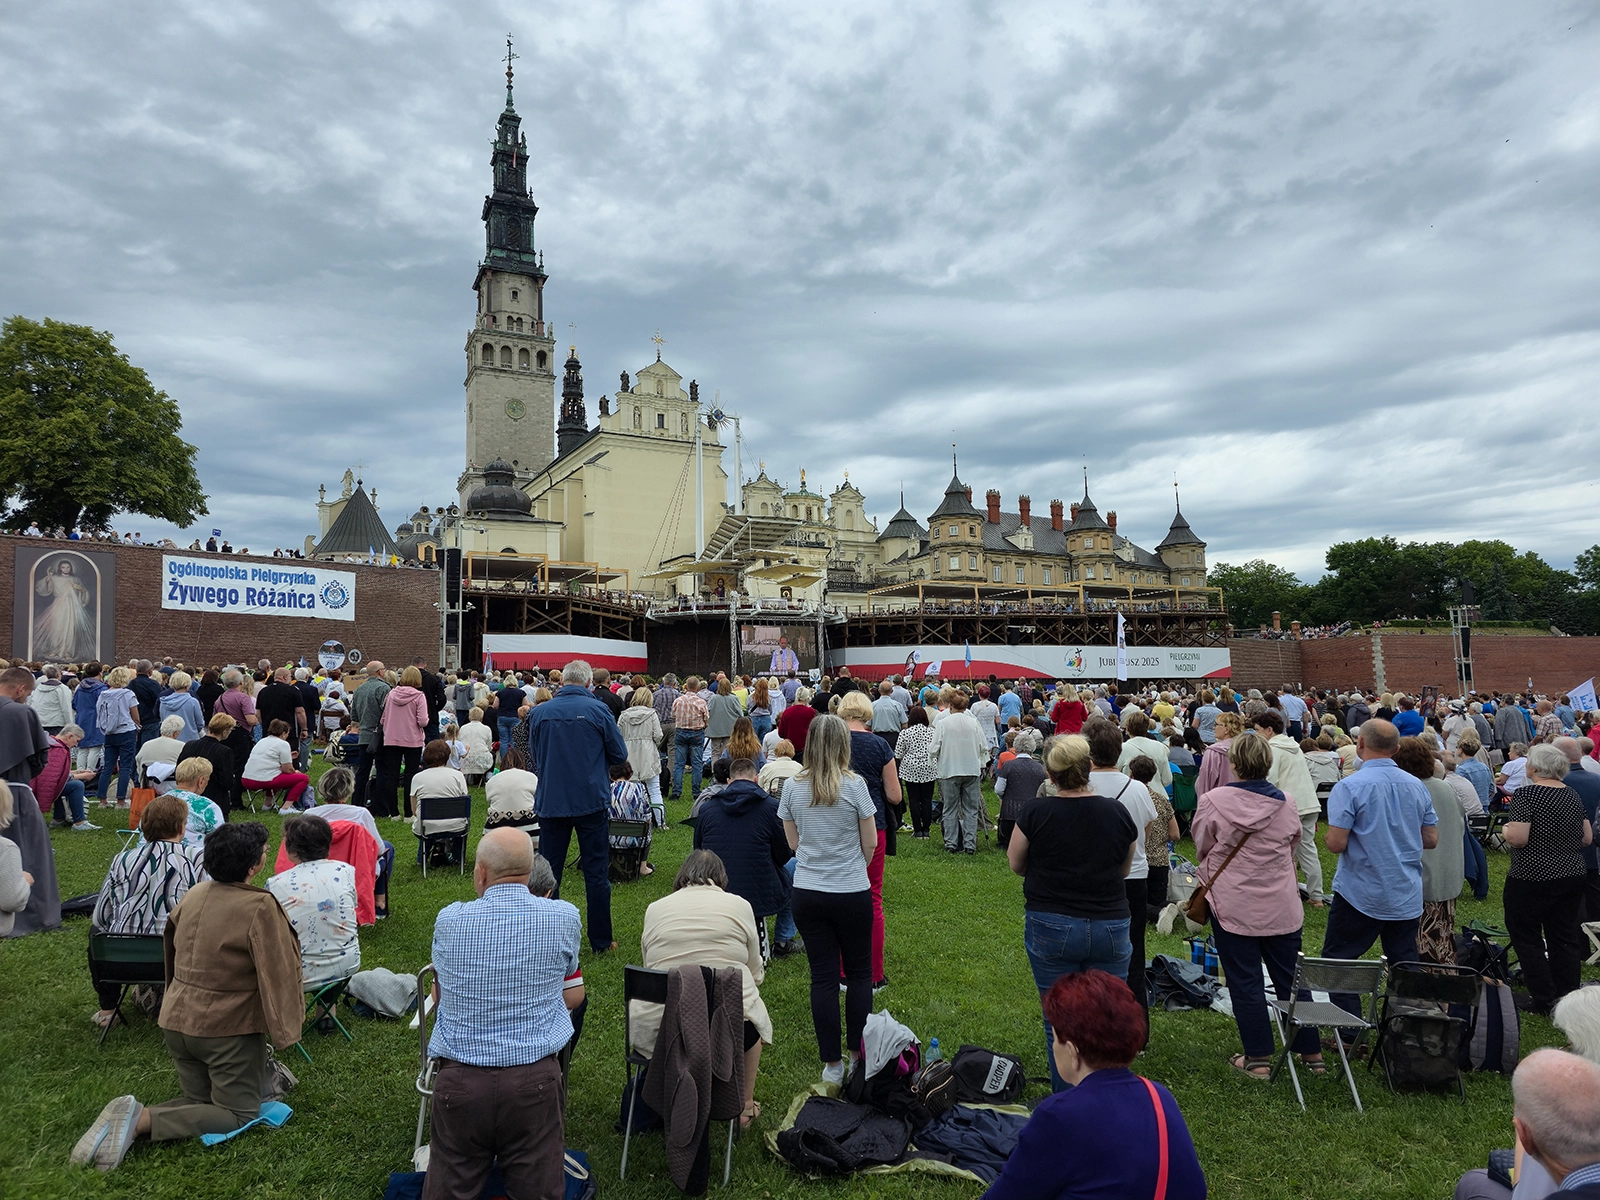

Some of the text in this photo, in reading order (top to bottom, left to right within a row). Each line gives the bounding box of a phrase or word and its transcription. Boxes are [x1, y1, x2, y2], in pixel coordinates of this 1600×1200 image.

[168, 561, 316, 586] Ogólnopolska Pielgrzymka
[168, 577, 316, 609] Żywego Różańca
[1099, 657, 1140, 669] JUBIUSZ
[1141, 657, 1160, 666] 2025
[1170, 652, 1201, 661] PIELGRZYMI
[988, 1059, 1008, 1091] COOPER
